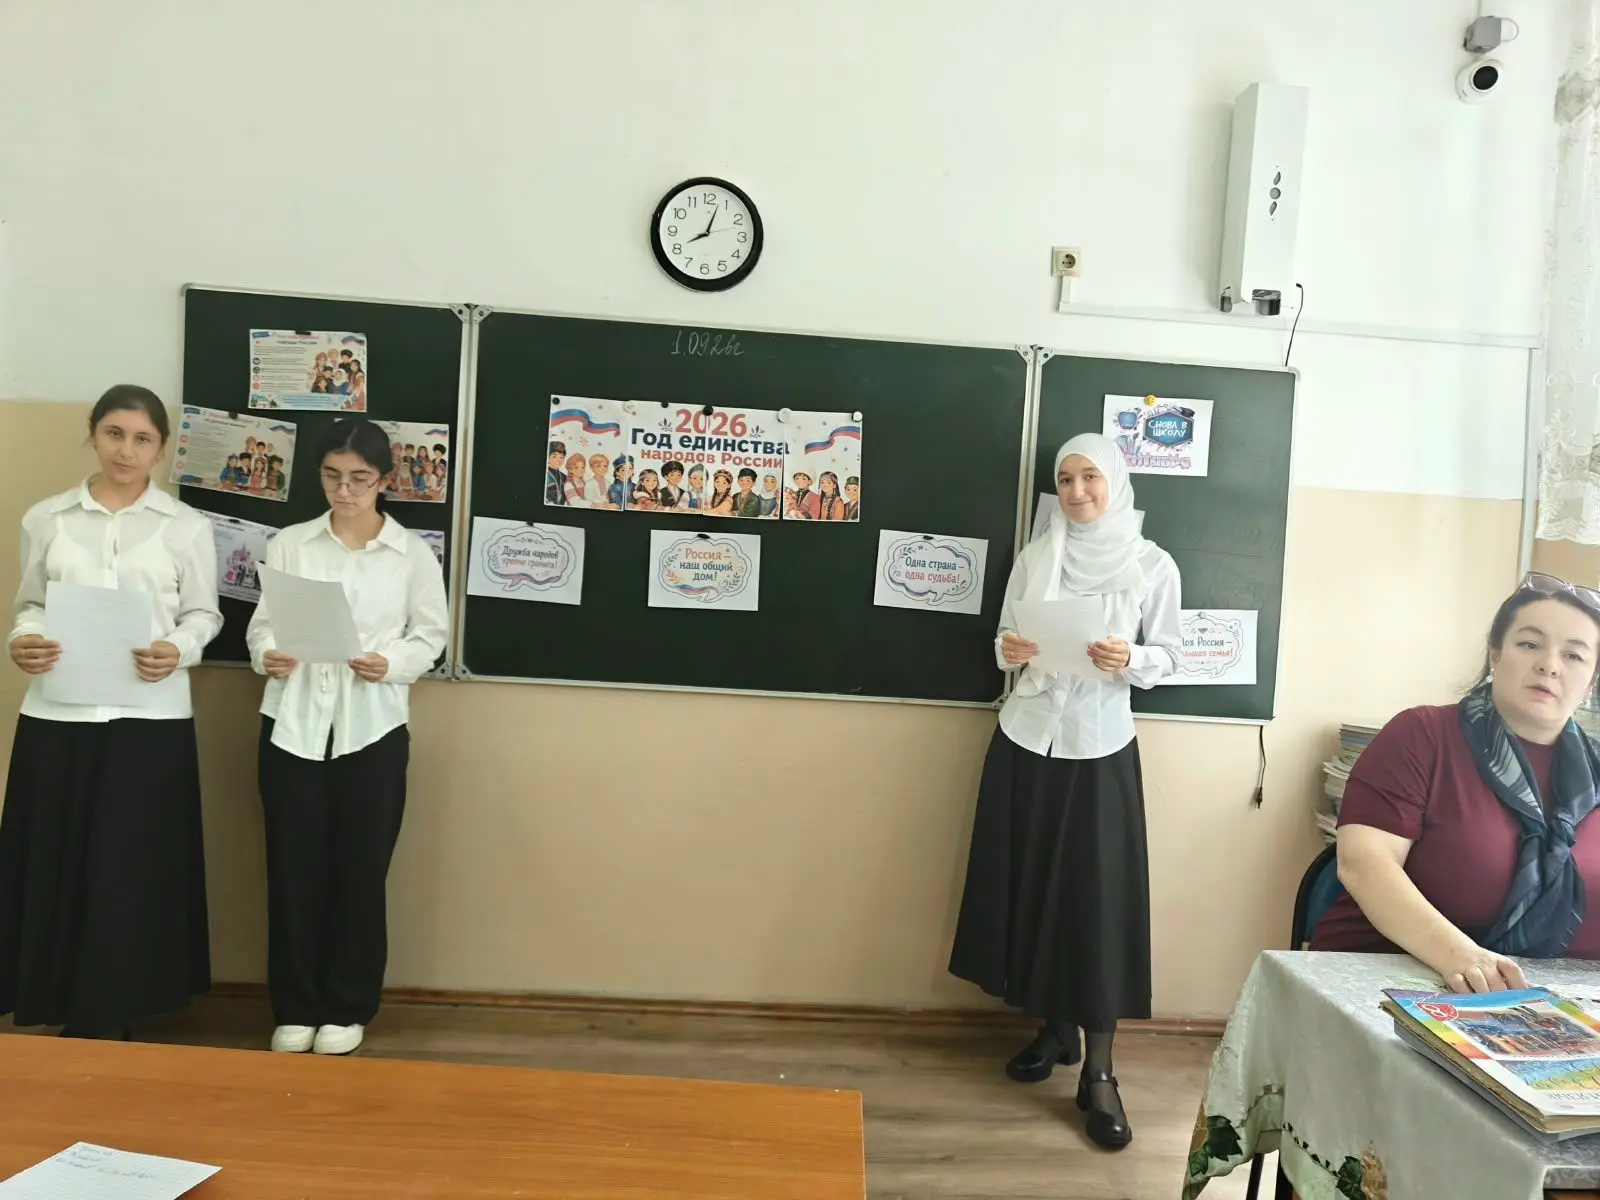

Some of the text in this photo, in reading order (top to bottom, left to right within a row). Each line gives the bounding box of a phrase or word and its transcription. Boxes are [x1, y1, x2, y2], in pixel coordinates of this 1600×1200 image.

[687, 196, 697, 208] 11
[703, 193, 717, 206] 12
[674, 207, 687, 220] 10
[733, 213, 743, 226] 2
[667, 225, 678, 237] 9
[736, 231, 747, 243] 3
[672, 243, 682, 255] 8
[730, 249, 740, 260] 4
[684, 257, 694, 268] 7
[717, 260, 728, 272] 5
[699, 263, 710, 275] 6
[674, 409, 748, 438] 2026
[1148, 419, 1188, 429] СНОВА В
[1152, 428, 1187, 437] ШКОЛУ
[631, 428, 790, 456] Год единства
[640, 448, 784, 469] народов России
[501, 545, 559, 560] Дружба народов
[685, 548, 722, 560] Россия
[679, 561, 733, 572] наш общий
[905, 556, 926, 569] Одна
[928, 560, 957, 571] страна
[693, 572, 717, 581] дом!
[905, 570, 960, 585] одна судьба!
[1197, 636, 1225, 647] Россия
